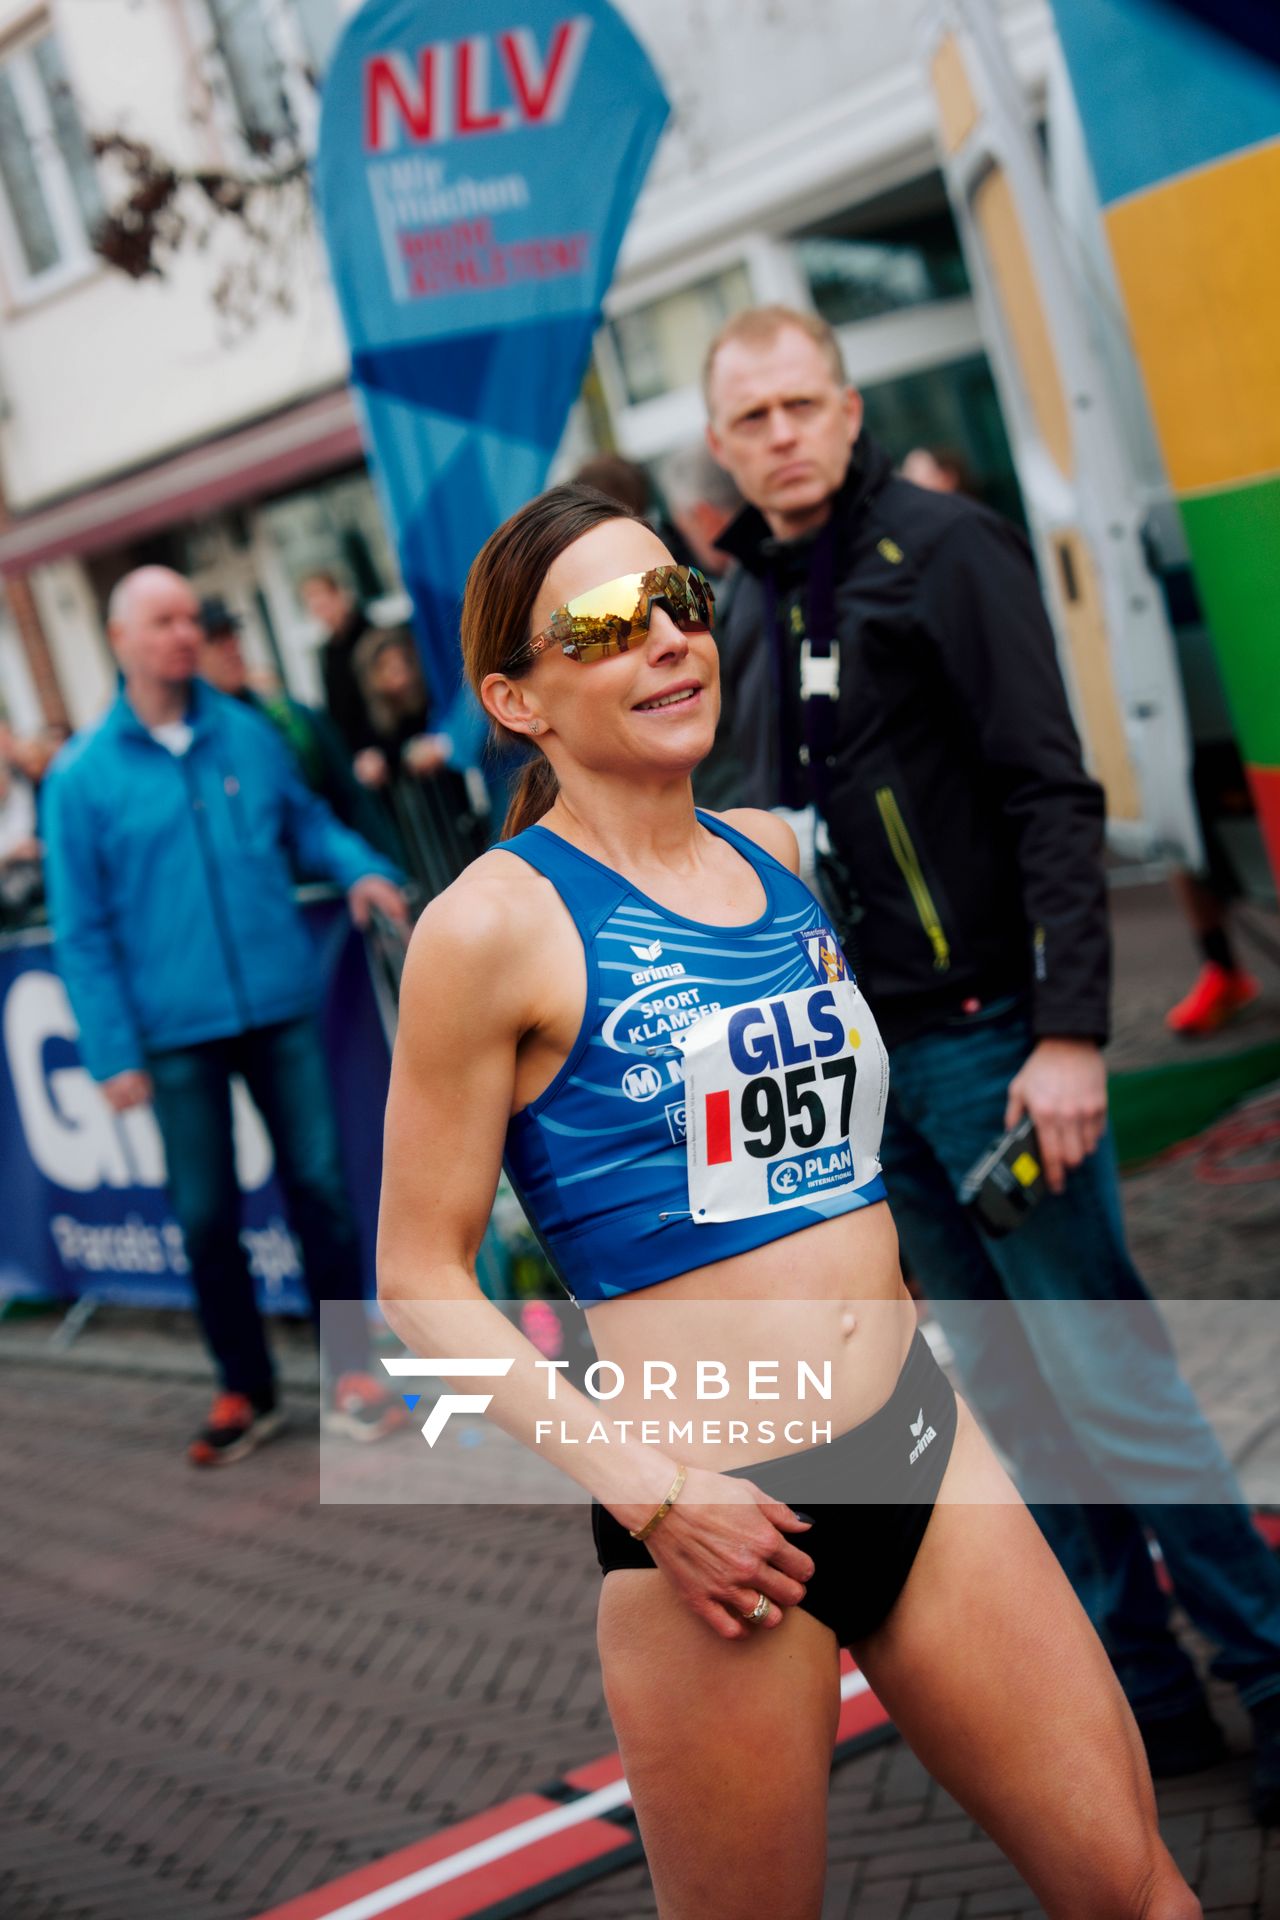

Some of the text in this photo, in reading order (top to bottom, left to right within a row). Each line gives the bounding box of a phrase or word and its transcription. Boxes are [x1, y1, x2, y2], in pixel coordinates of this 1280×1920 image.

[364, 14, 591, 154] NLV
[631, 962, 686, 986] erima
[640, 988, 701, 1020] SPORT
[741, 1056, 857, 1159] 957
[804, 1150, 851, 1179] PLAN
[807, 1171, 852, 1188] INTERNATIONAL
[909, 1425, 937, 1465] erima
